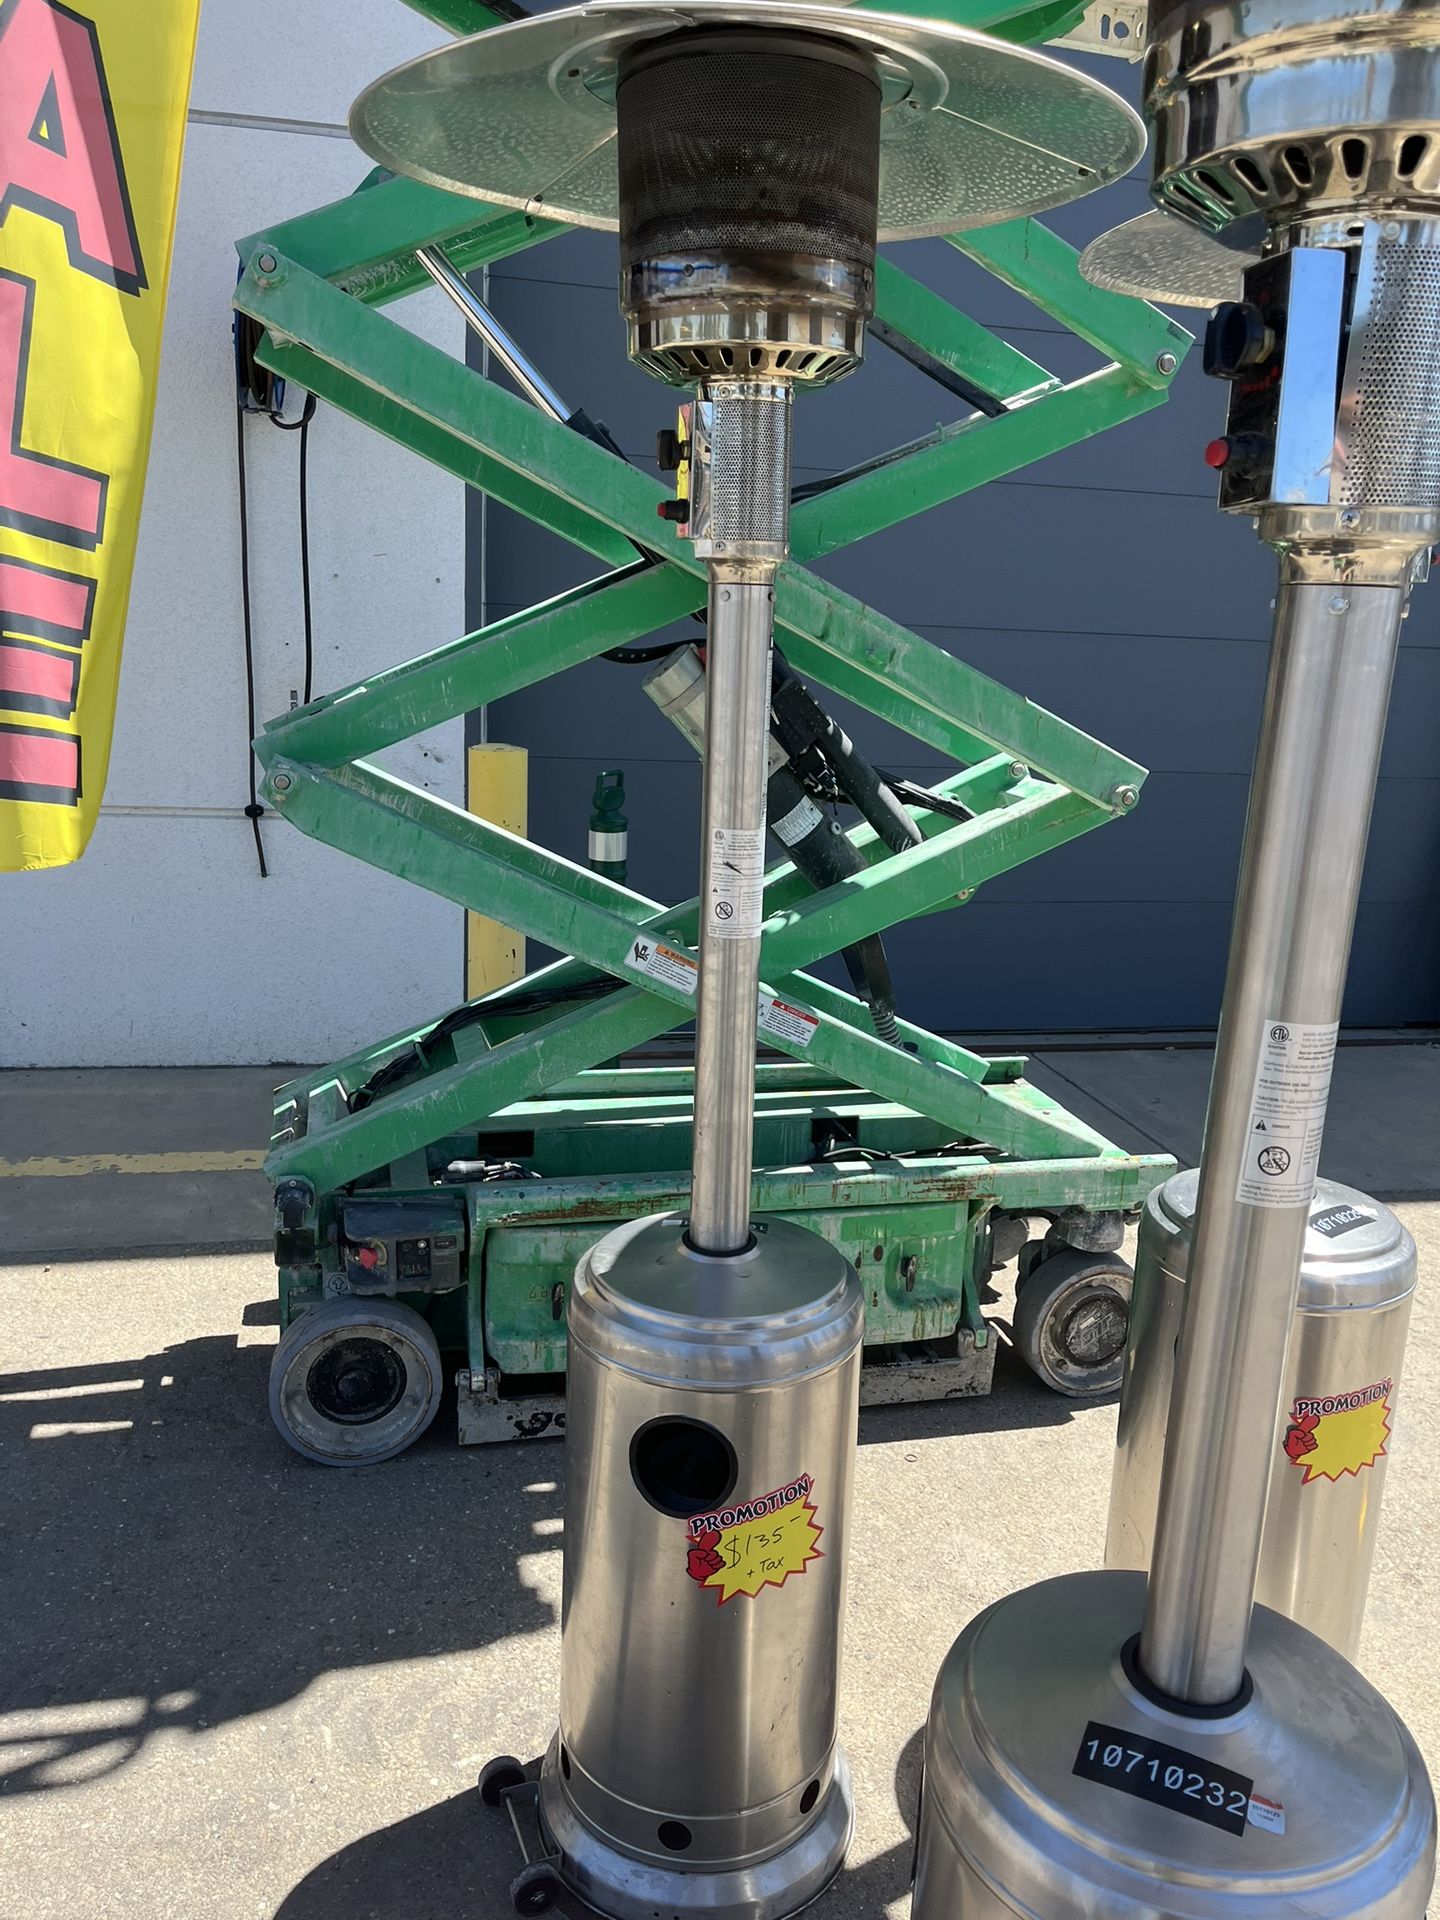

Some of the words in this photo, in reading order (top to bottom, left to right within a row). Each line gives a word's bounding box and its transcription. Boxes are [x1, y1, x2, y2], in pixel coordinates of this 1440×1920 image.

[1272, 1027, 1288, 1041] ETL
[1312, 1209, 1362, 1232] 1071022
[1296, 1380, 1390, 1417] PROMOTION
[690, 1477, 810, 1536] PROMOTION
[760, 1557, 785, 1573] Tax
[1087, 1739, 1249, 1817] 10710232
